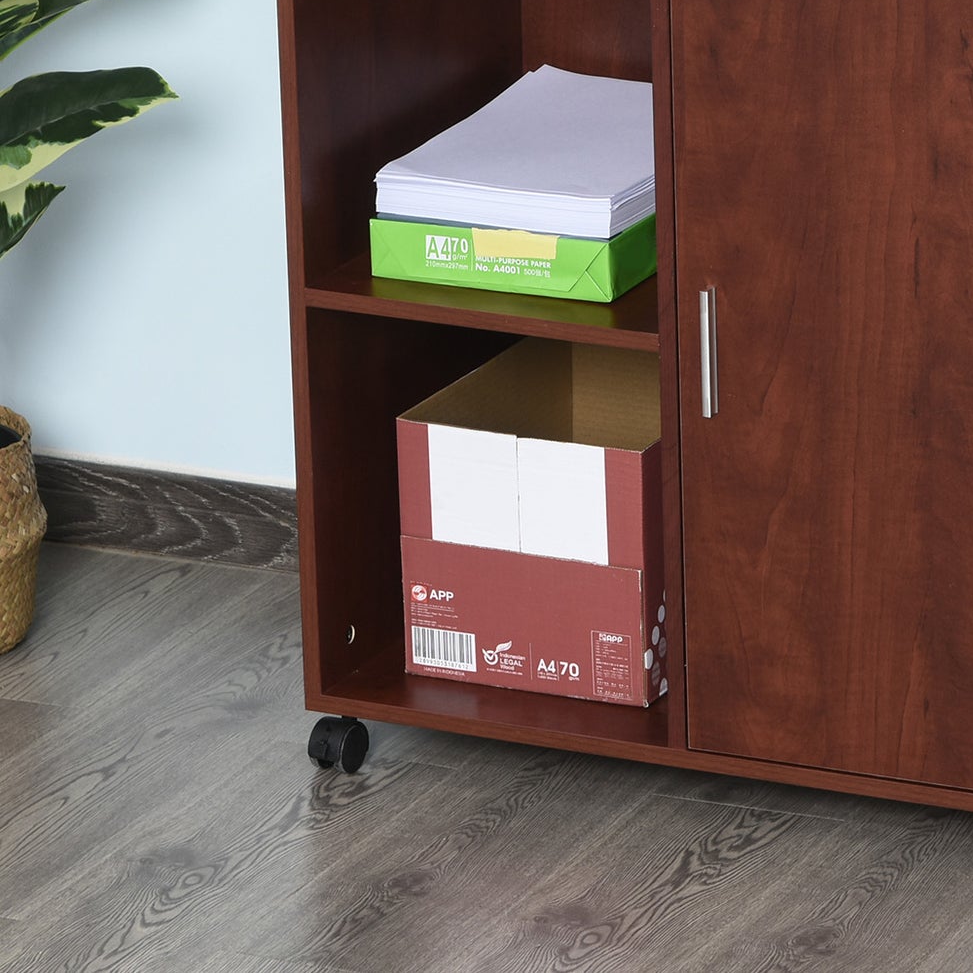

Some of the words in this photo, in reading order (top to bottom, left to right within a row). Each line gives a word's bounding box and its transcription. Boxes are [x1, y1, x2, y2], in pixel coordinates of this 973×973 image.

[426, 235, 451, 260] A4
[451, 237, 469, 254] 70
[475, 256, 529, 267] MULTI-PURPOSE
[530, 259, 552, 269] PAPER
[475, 263, 491, 273] No.
[493, 264, 521, 275] A4001
[429, 589, 455, 602] APP
[606, 635, 624, 644] APP
[500, 653, 526, 661] Indonesian
[500, 657, 523, 667] LEGAL
[537, 659, 557, 674] A4
[560, 661, 580, 678] 70
